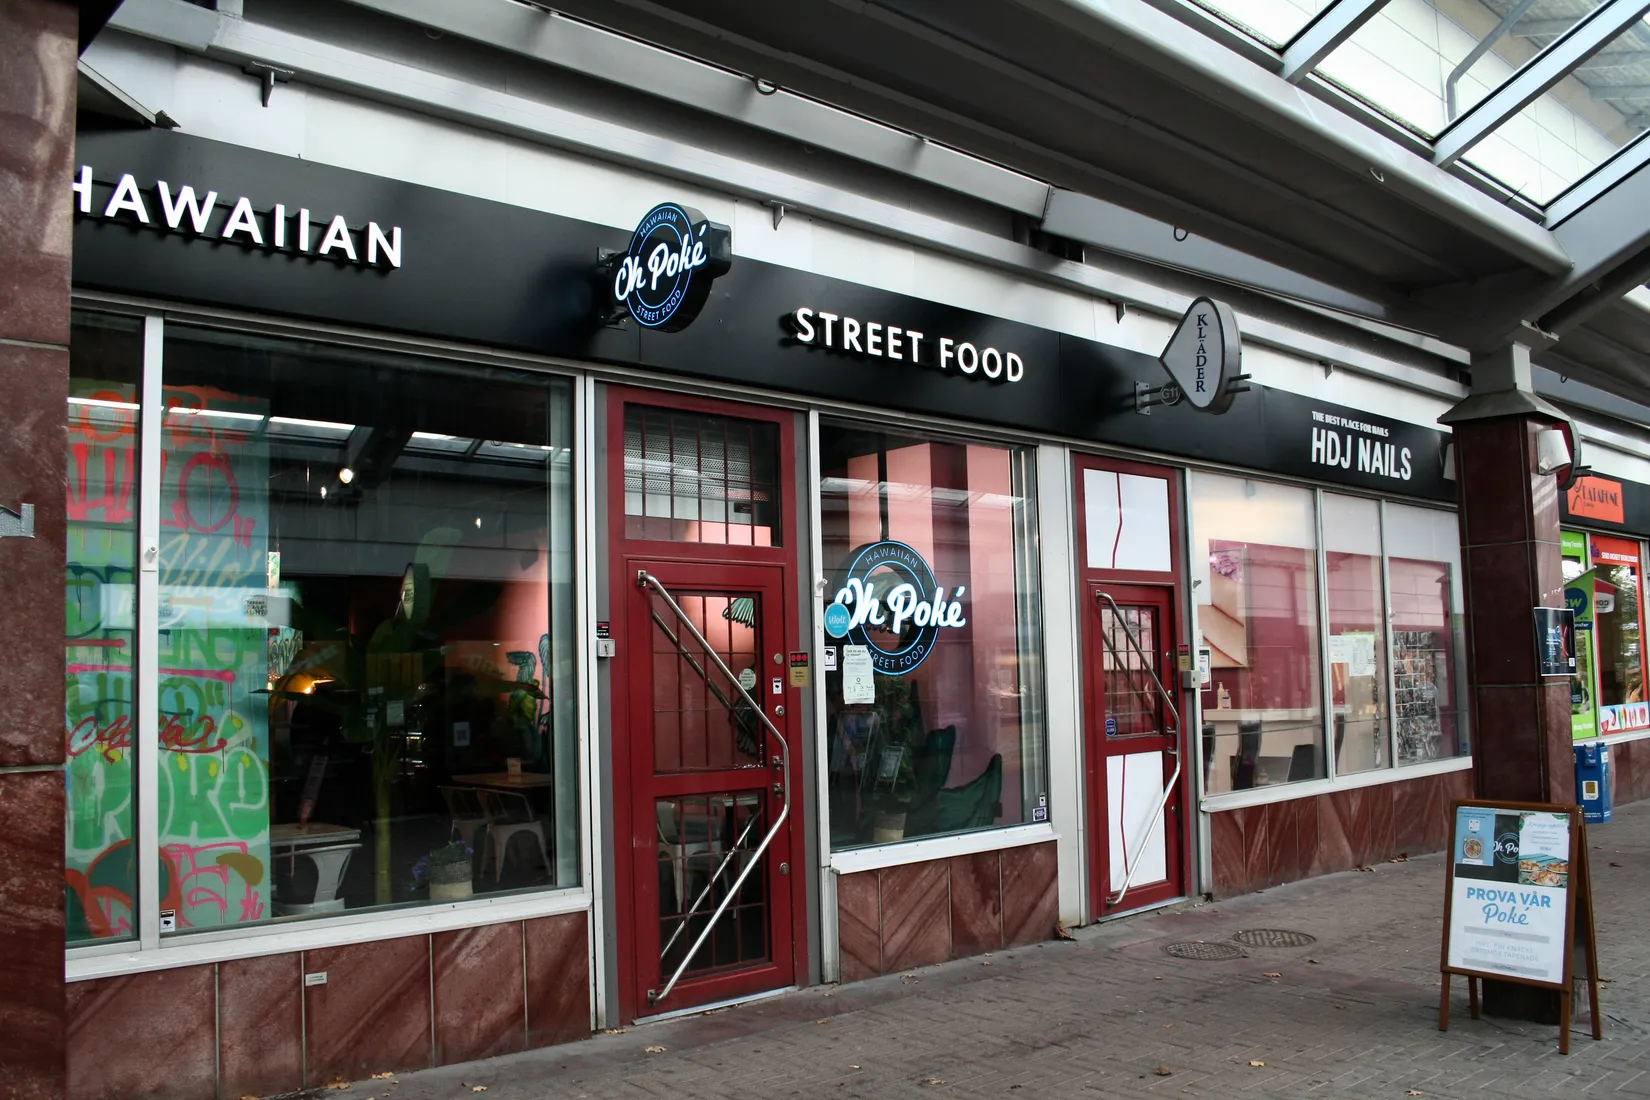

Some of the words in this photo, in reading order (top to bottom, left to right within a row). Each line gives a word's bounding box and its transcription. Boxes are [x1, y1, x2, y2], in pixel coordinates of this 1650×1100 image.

[71, 165, 401, 268] HAWAIIAN
[640, 211, 678, 238] HAWAIIAN
[615, 255, 646, 300] Oh
[647, 223, 707, 291] Poké
[636, 305, 660, 321] STREET
[661, 289, 681, 316] FOOD
[796, 307, 923, 363] STREET
[940, 337, 1024, 382] FOOD
[1195, 313, 1208, 393] KLÄDER
[1161, 387, 1179, 399] G11
[1312, 410, 1324, 422] THE
[1325, 414, 1341, 426] BEST
[1341, 417, 1360, 431] PLACE
[1360, 422, 1372, 433] FOR
[1372, 425, 1389, 437] NAILS
[1311, 427, 1351, 469] HDJ
[1358, 437, 1412, 481] NAILS
[865, 548, 918, 568] HAWAIIAN
[834, 577, 885, 630] Oh
[886, 583, 966, 634] Poké
[828, 615, 847, 625] Wolt
[868, 648, 896, 669] TREET
[899, 644, 925, 668] FOOD
[1467, 887, 1517, 904] PROVA
[1520, 891, 1551, 908] VÅR
[1482, 903, 1529, 925] Poké
